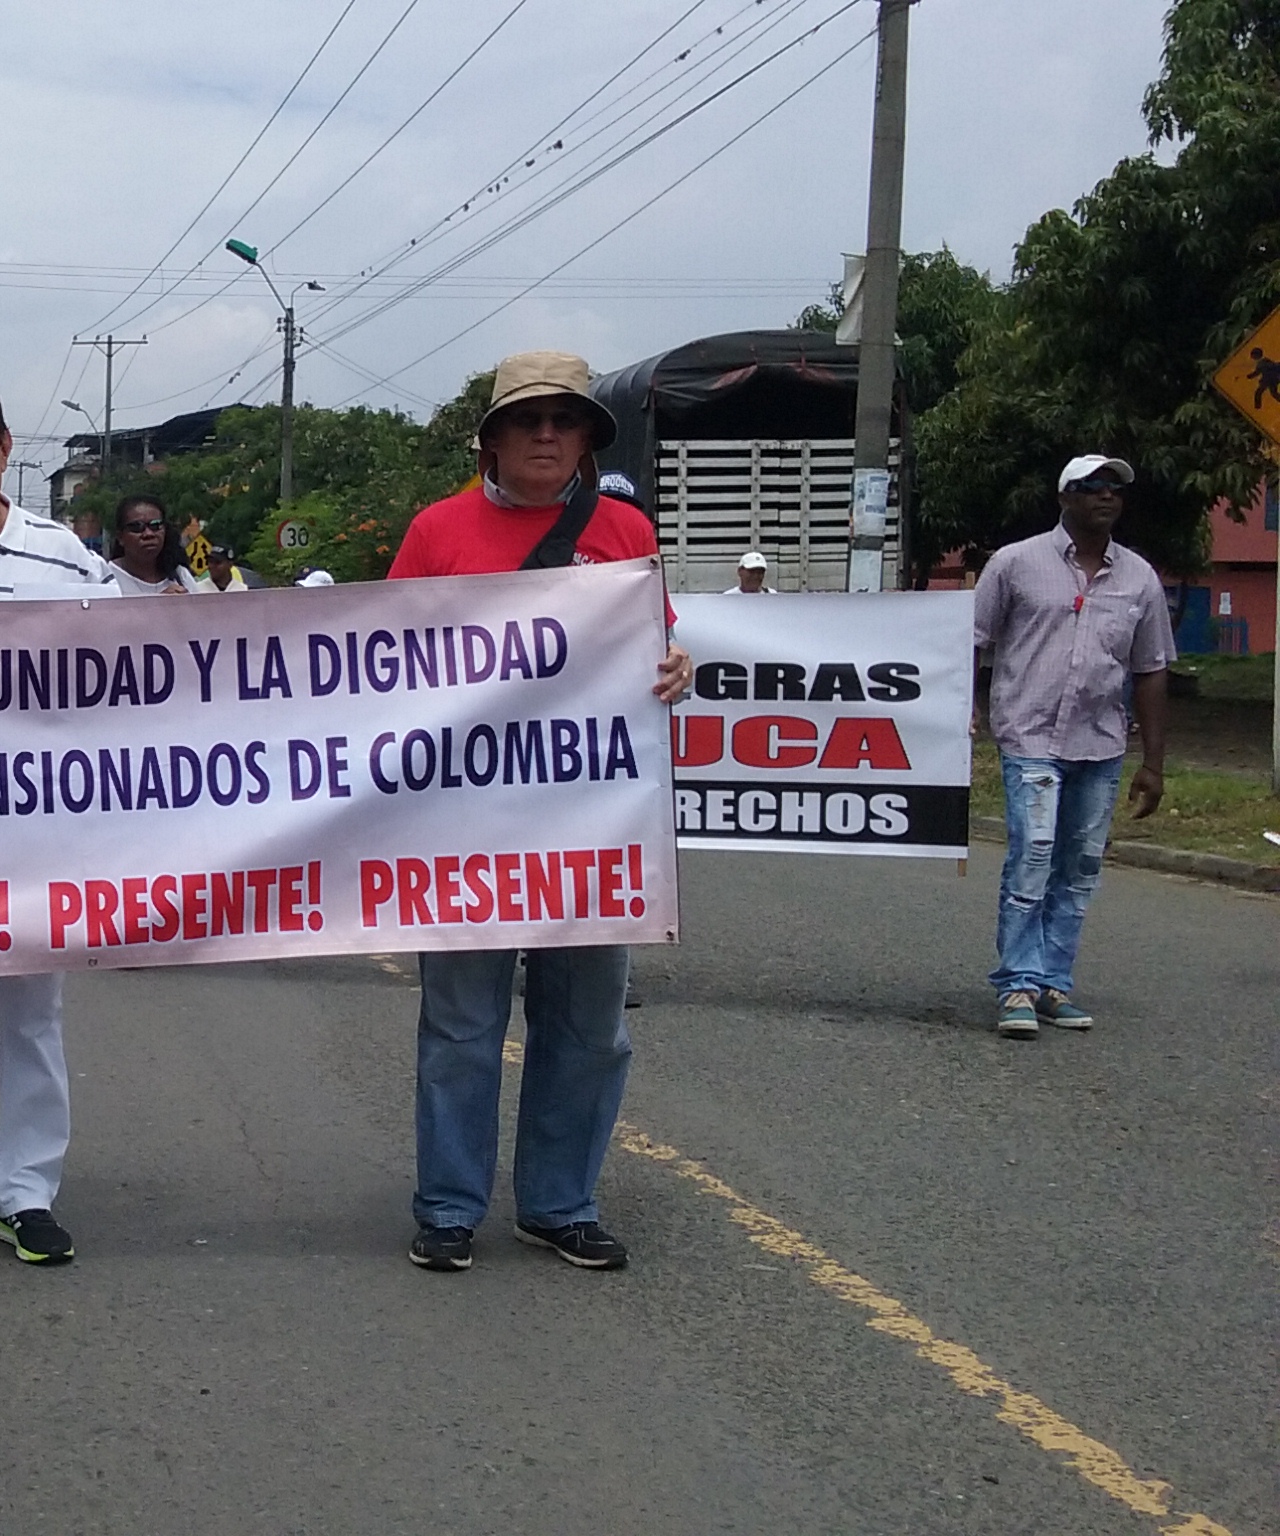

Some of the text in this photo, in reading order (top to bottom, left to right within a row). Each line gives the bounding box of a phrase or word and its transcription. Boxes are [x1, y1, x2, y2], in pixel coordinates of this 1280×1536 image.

[287, 526, 309, 547] 30
[188, 638, 221, 703] Y
[237, 635, 293, 701] LA
[308, 616, 568, 697] DIGNIDAD
[677, 661, 921, 702] GRAS
[288, 736, 352, 801] DE
[369, 715, 639, 795] COLOMBIA
[675, 789, 909, 836] RECHOS
[48, 860, 324, 949] PRESENTE!
[360, 844, 646, 927] PRESENTE!
